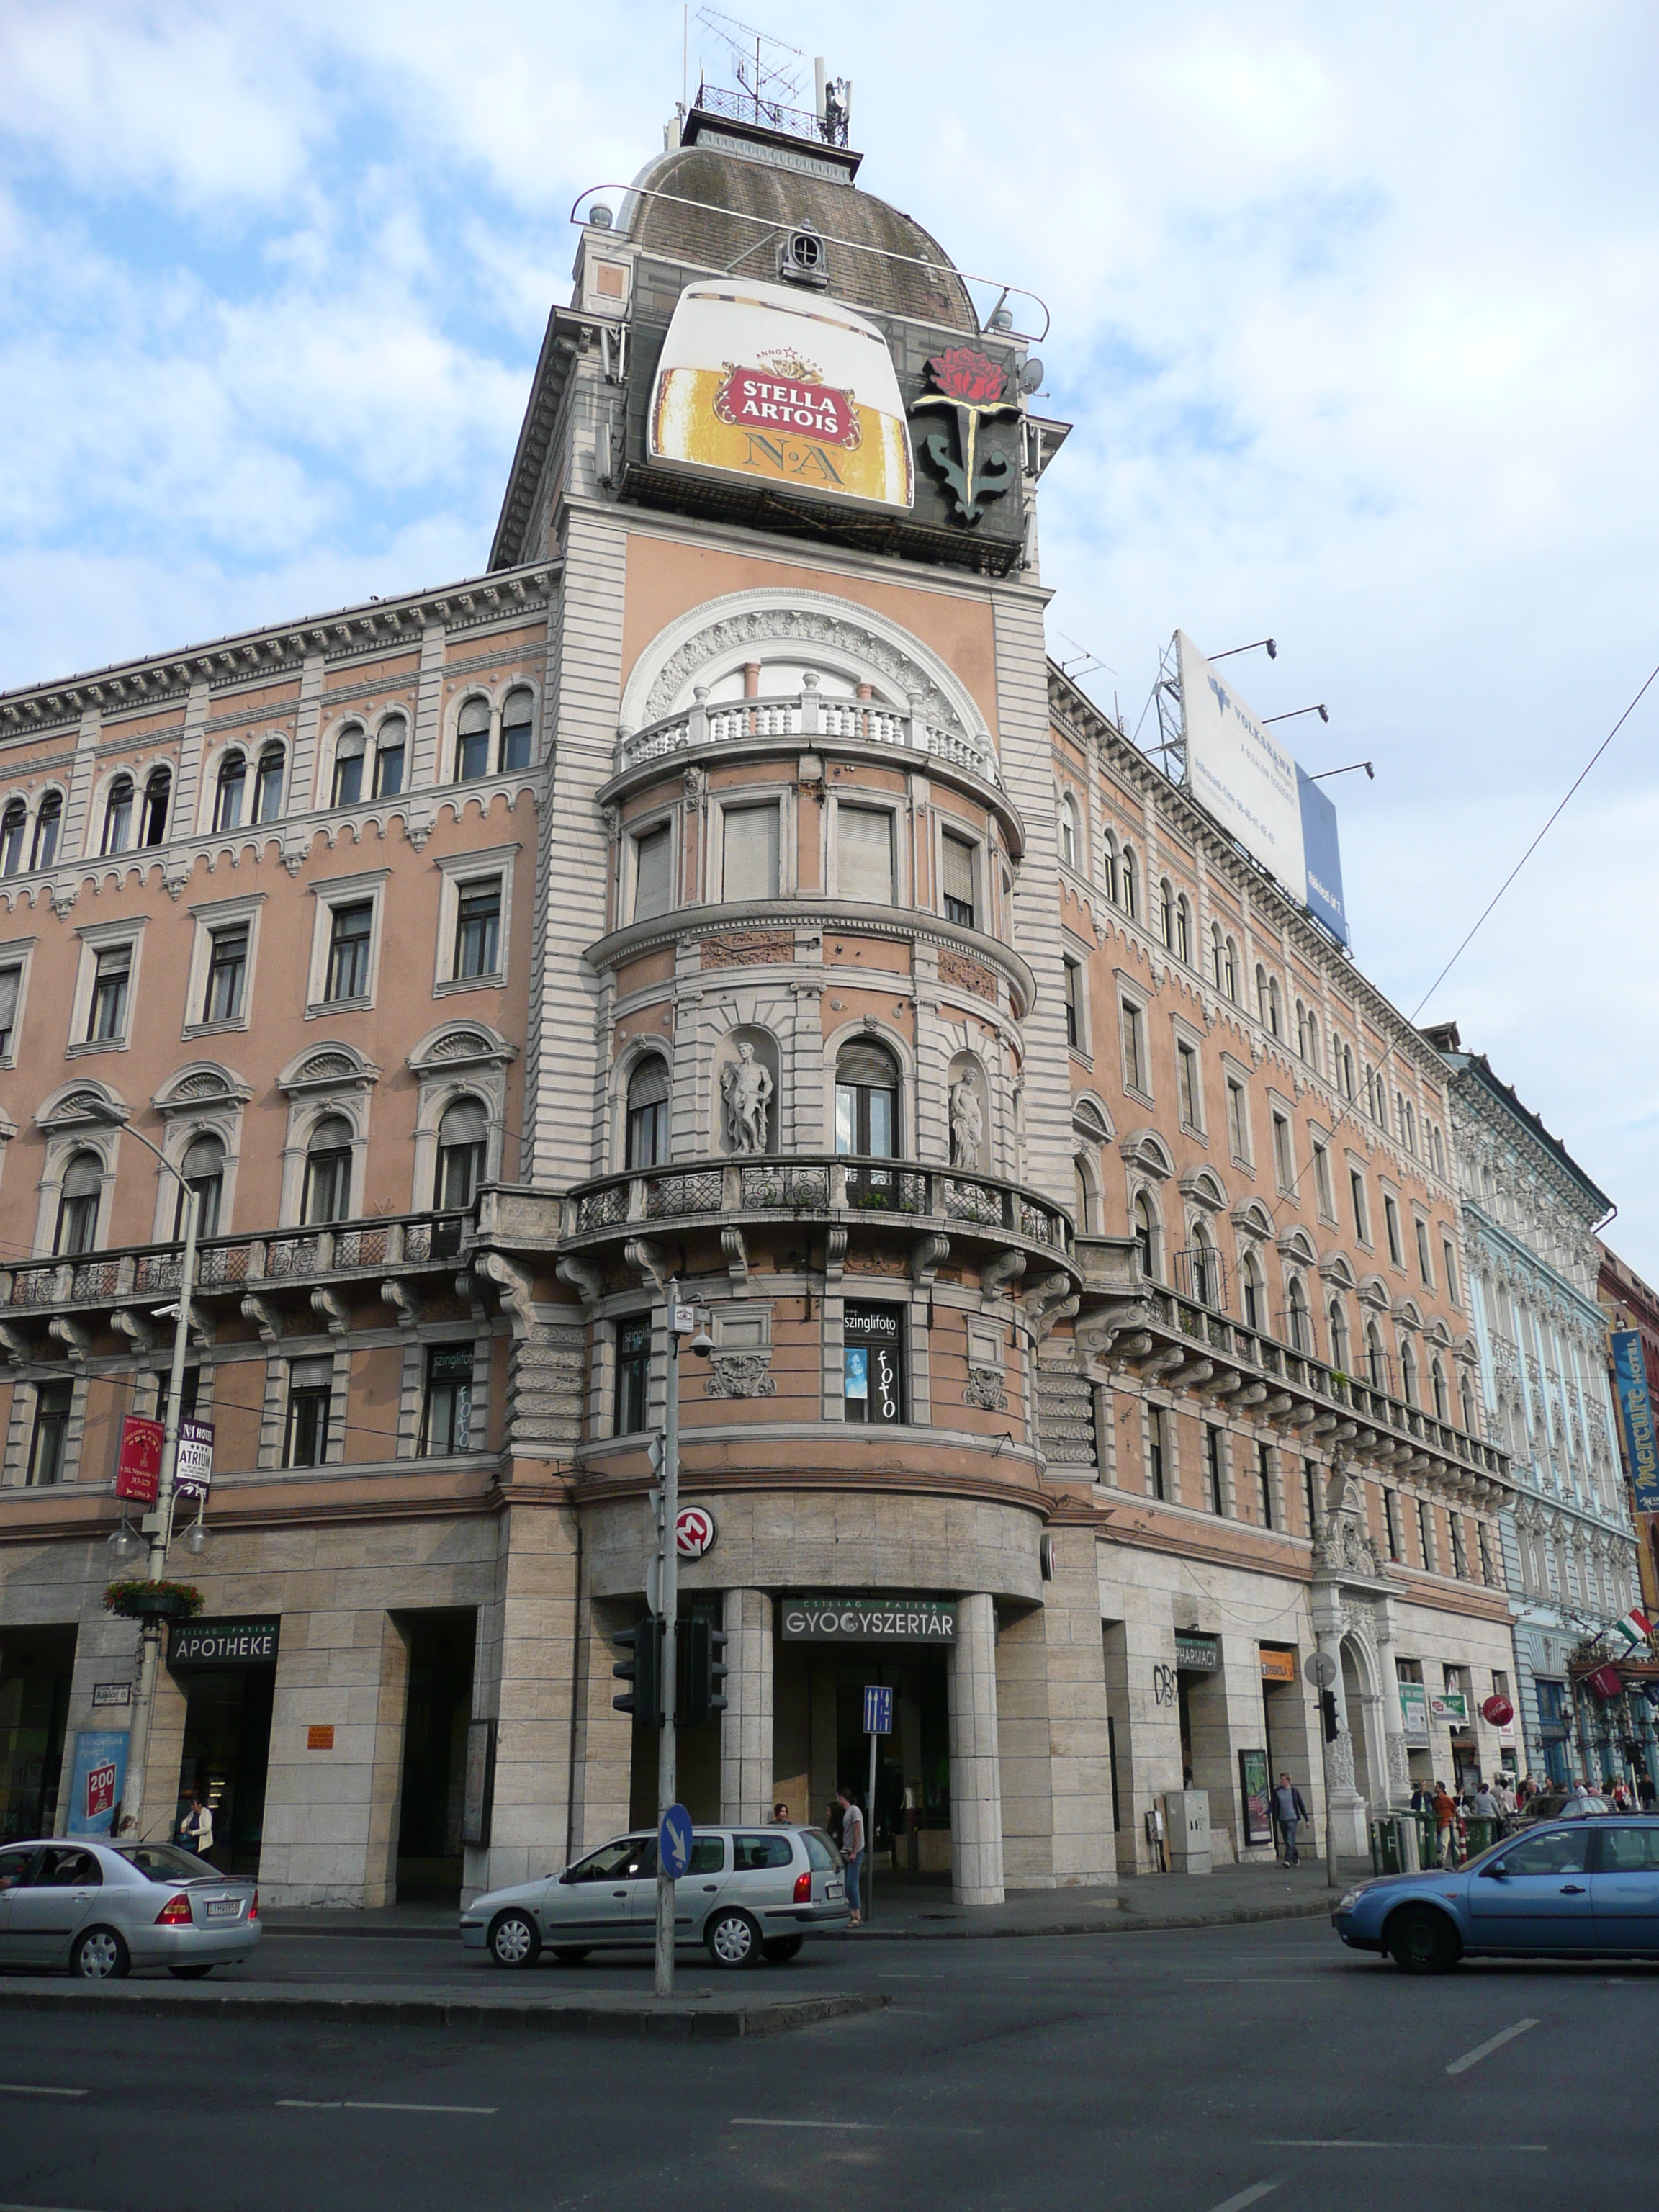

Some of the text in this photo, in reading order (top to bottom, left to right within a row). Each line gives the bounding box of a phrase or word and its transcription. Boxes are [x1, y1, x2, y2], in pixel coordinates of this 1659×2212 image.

[756, 349, 782, 359] ANNO
[743, 380, 837, 415] STELLA
[742, 400, 838, 433] ARTOIS
[1234, 705, 1293, 779] VOLKSBANK
[845, 1313, 896, 1333] szinglifoto
[1627, 1338, 1642, 1384] HOTEL
[877, 1350, 896, 1418] foto
[457, 1385, 471, 1447] foto
[196, 1426, 212, 1442] HOTEL
[179, 1449, 211, 1469] ATRIUM
[886, 1601, 938, 1610] PATIKA
[786, 1608, 953, 1635] GYÓGYSZERTÁR
[176, 1636, 272, 1658] APOTHEKE
[1175, 1647, 1216, 1666] PHARMACY
[91, 1769, 114, 1792] 200
